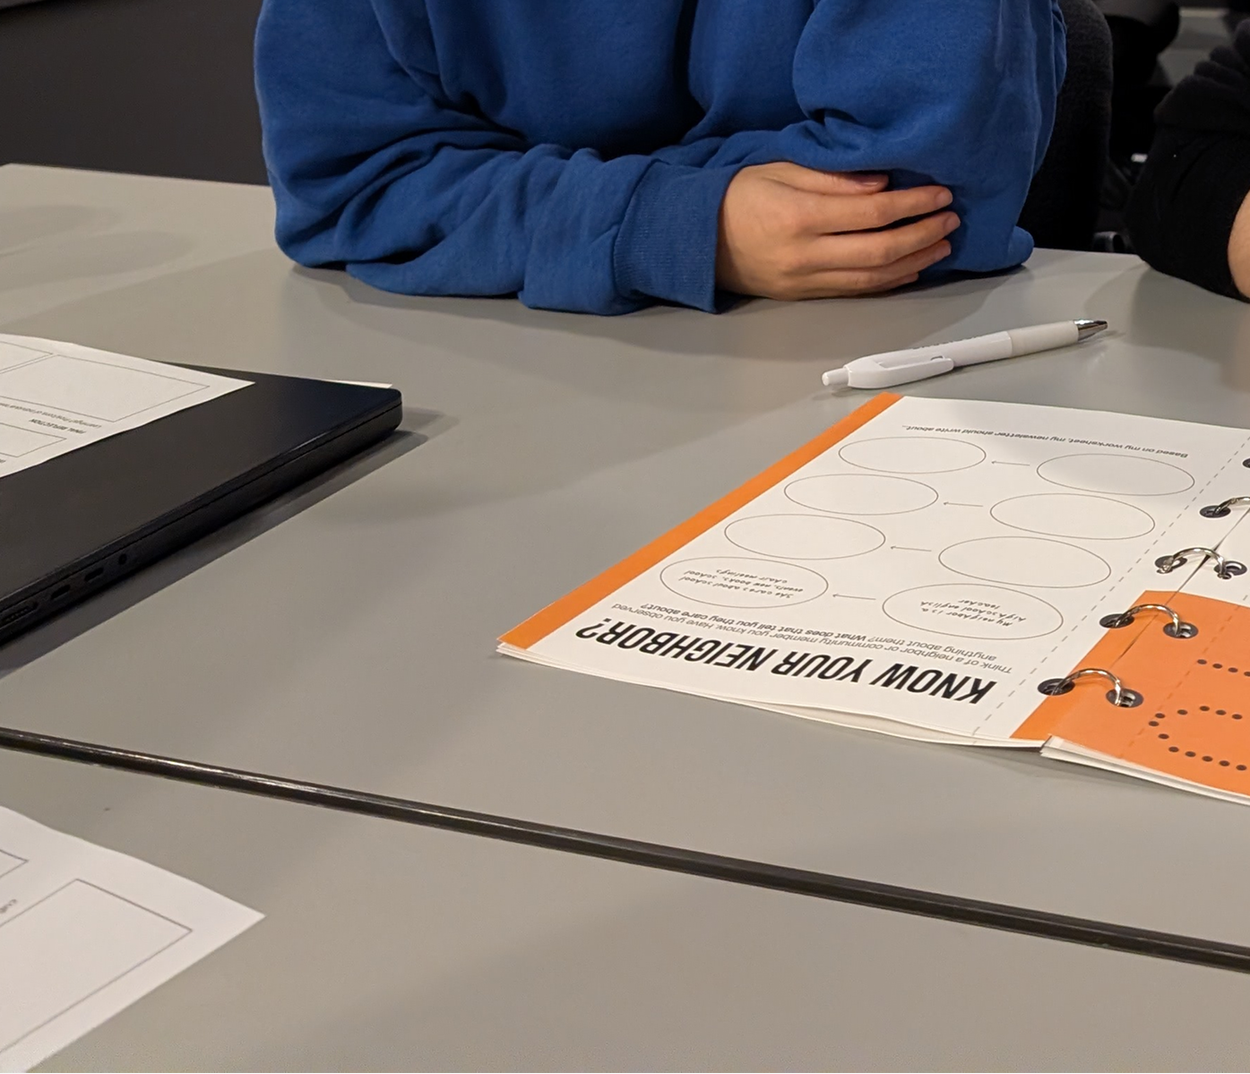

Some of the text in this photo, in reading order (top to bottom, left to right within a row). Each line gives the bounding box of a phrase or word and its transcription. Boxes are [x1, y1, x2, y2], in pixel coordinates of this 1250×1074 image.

[994, 432, 1050, 441] newsletter
[1068, 438, 1123, 449] worksheet,
[1155, 449, 1189, 459] Based
[611, 603, 664, 619] observed
[663, 612, 691, 624] you
[685, 619, 715, 630] Have
[715, 624, 748, 635] know.
[640, 603, 997, 662] anything about them? What does that tell you they care about?
[746, 627, 774, 637] you
[769, 633, 819, 644] member
[818, 635, 890, 650] community
[899, 644, 955, 661] neighbor
[575, 618, 998, 704] KNOW YOUR NEIGHBOR?
[979, 661, 1013, 674] Think
